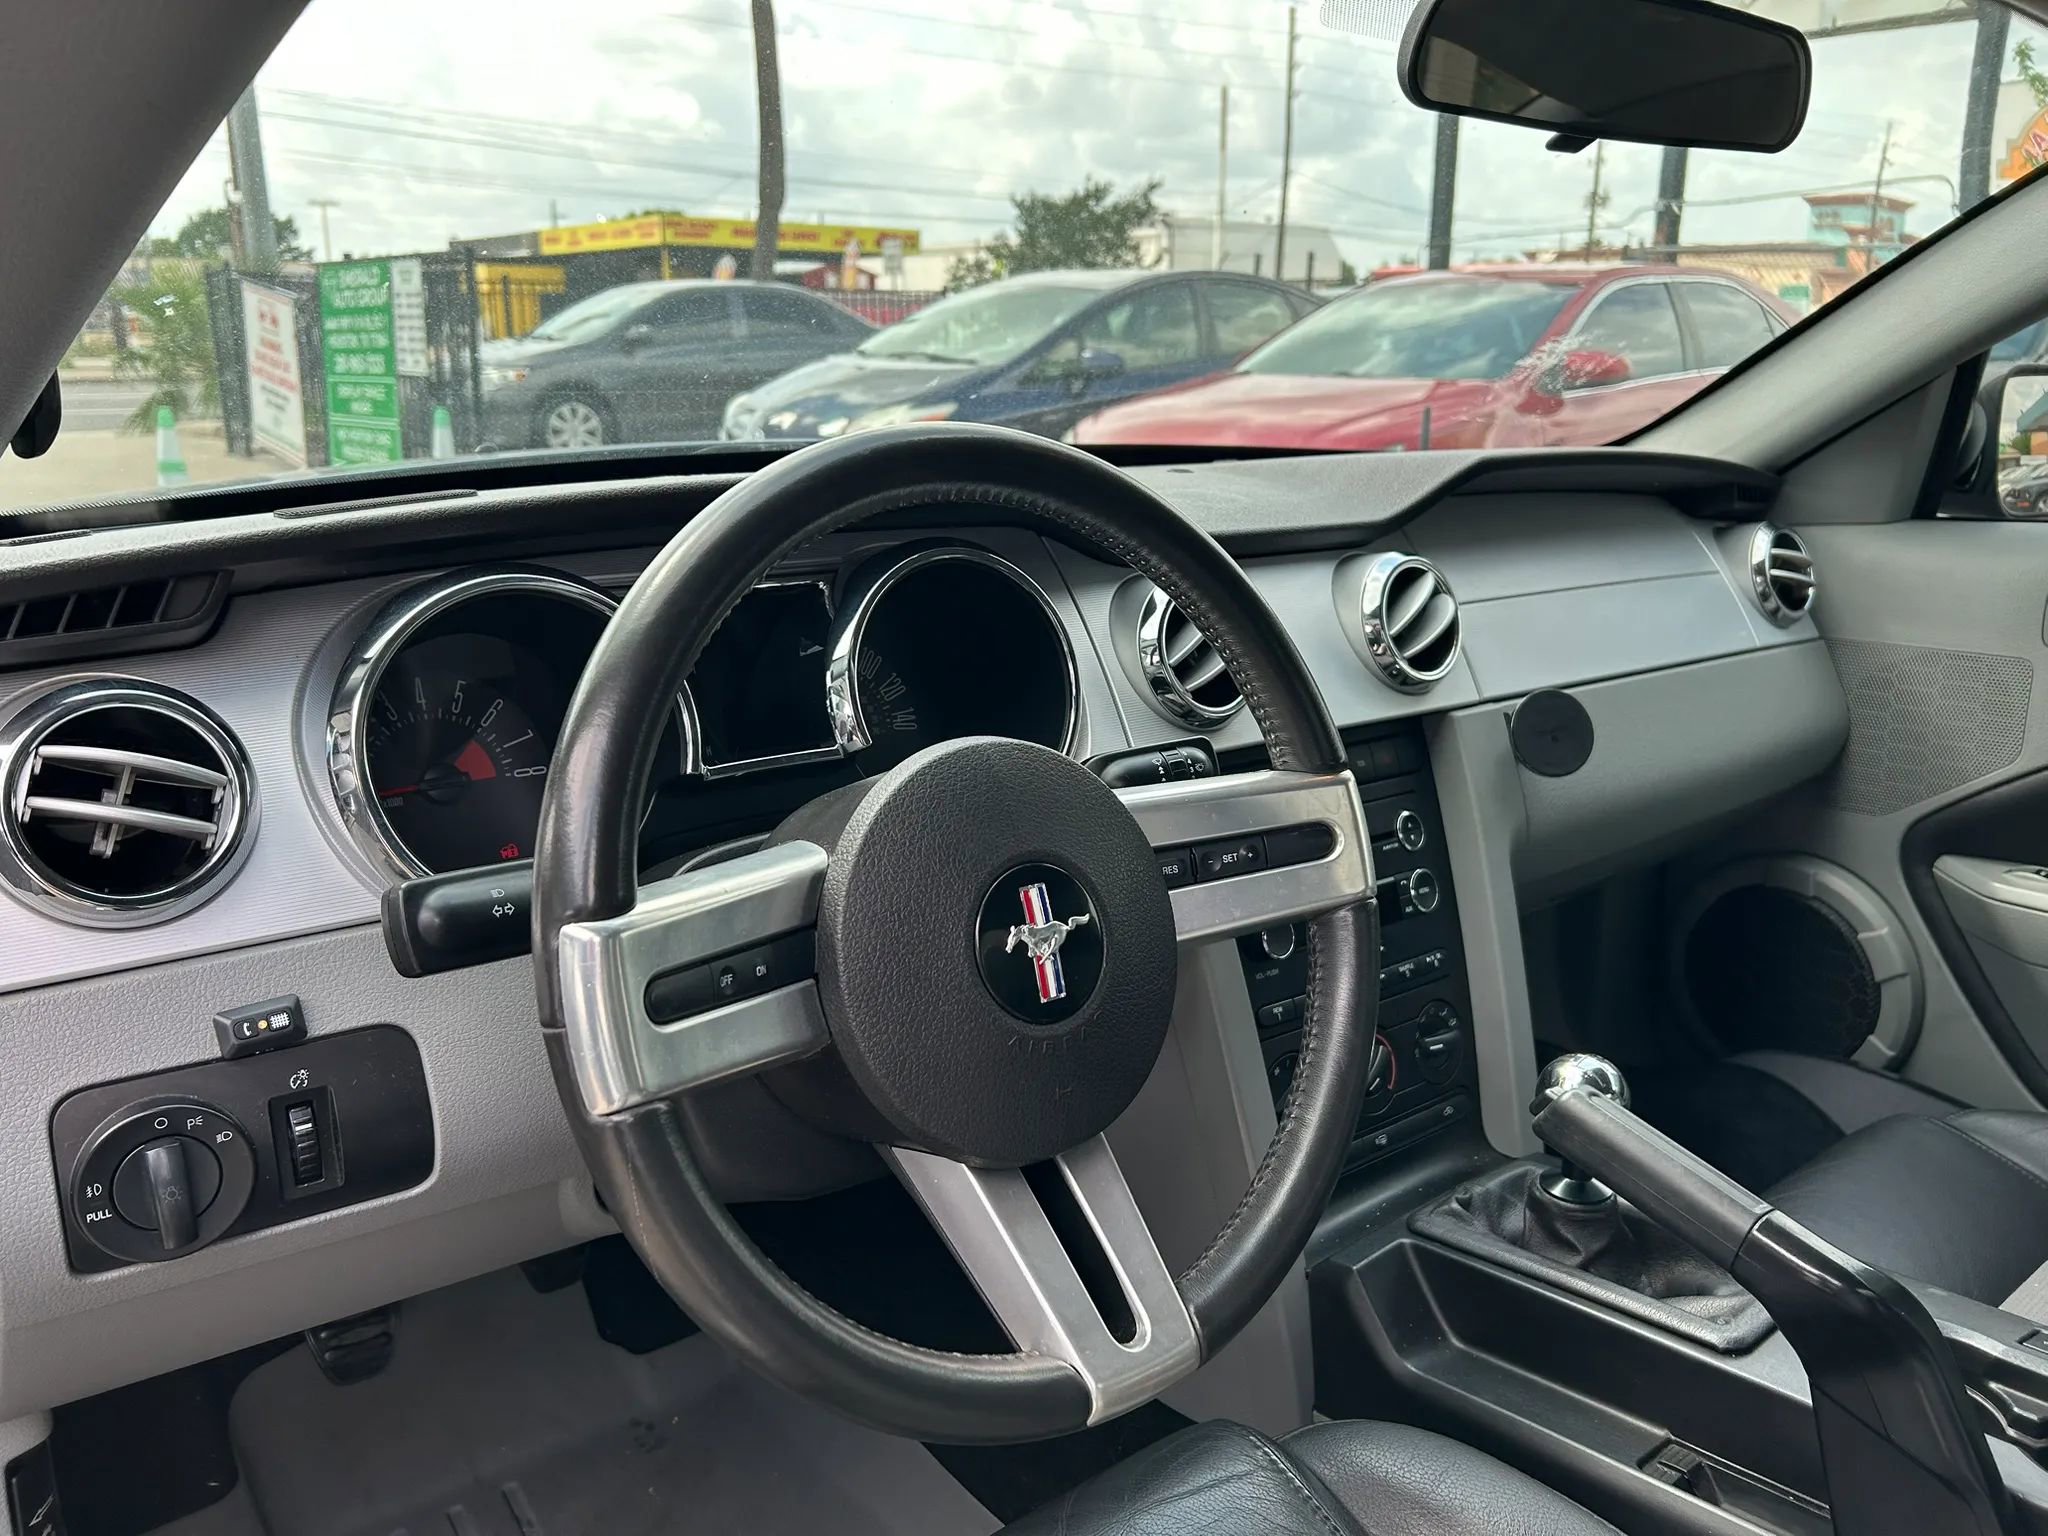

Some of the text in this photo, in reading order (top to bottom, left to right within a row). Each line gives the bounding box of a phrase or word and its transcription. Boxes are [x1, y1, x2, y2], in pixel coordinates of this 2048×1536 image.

[859, 646, 883, 680] 100
[414, 677, 427, 711] 4
[879, 672, 906, 702] 120
[452, 680, 467, 714] 5
[480, 699, 504, 728] 6
[891, 706, 918, 730] 140
[502, 729, 534, 748] 7
[513, 765, 548, 778] 8
[1222, 853, 1239, 864] SET
[1162, 864, 1180, 876] RES
[720, 973, 733, 987] OFF
[756, 964, 767, 977] ON
[86, 1209, 113, 1223] PULL
